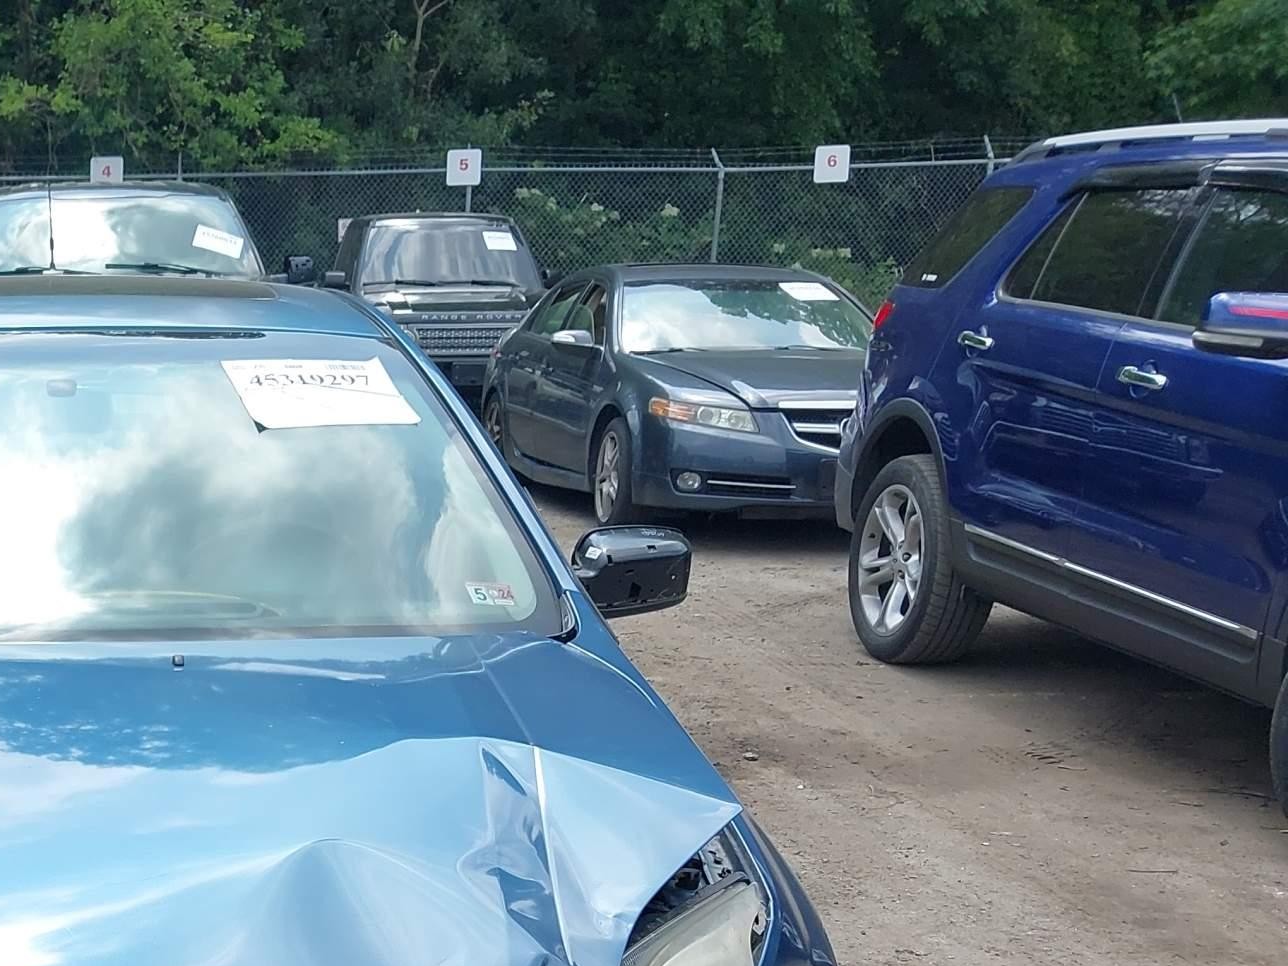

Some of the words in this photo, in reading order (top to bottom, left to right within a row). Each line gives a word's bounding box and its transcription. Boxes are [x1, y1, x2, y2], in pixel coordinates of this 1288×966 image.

[459, 158, 470, 171] 5
[827, 154, 838, 168] 6
[102, 165, 112, 178] 4
[249, 373, 370, 387] 45319297
[474, 587, 488, 601] 5
